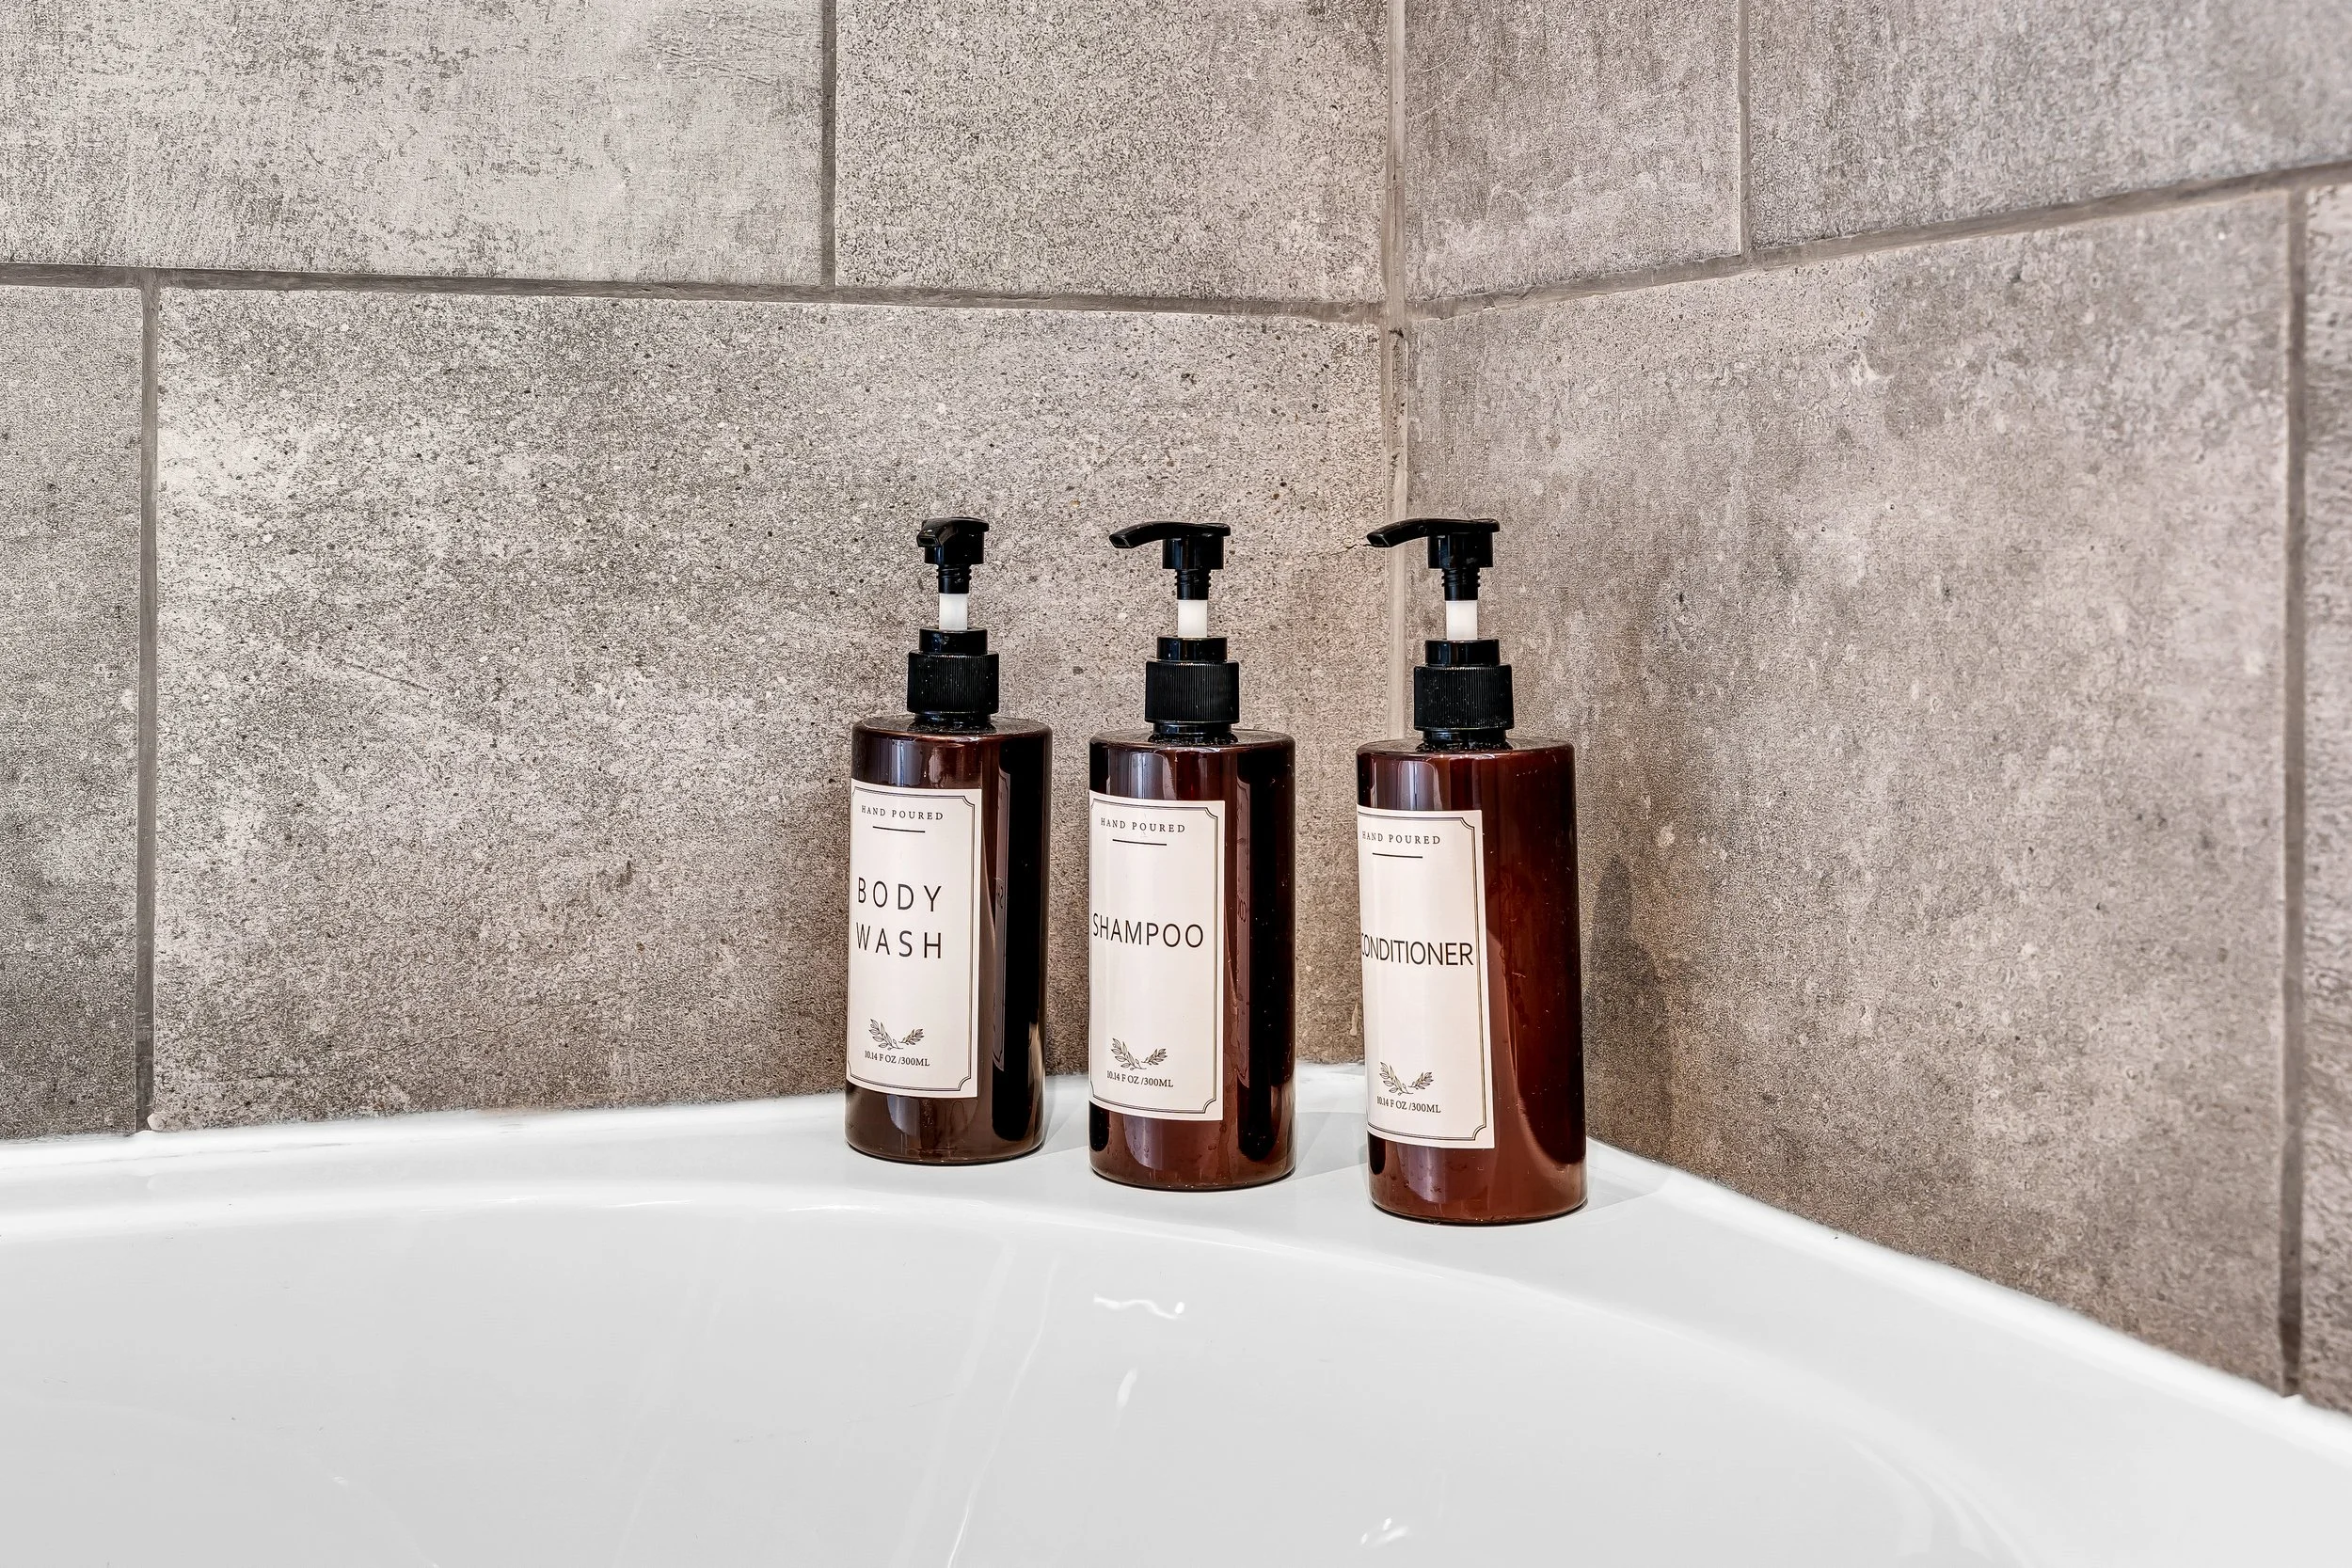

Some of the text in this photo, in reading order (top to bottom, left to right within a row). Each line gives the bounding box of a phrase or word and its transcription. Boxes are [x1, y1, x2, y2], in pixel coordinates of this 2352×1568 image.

[861, 804, 944, 820] HAND POURED
[1100, 817, 1185, 833] HAND POURED
[1389, 833, 1441, 845] POURED
[858, 877, 942, 912] BODY
[1092, 912, 1204, 948] SHAMPOO
[856, 922, 942, 959] WASH
[865, 1050, 878, 1061] 10.14
